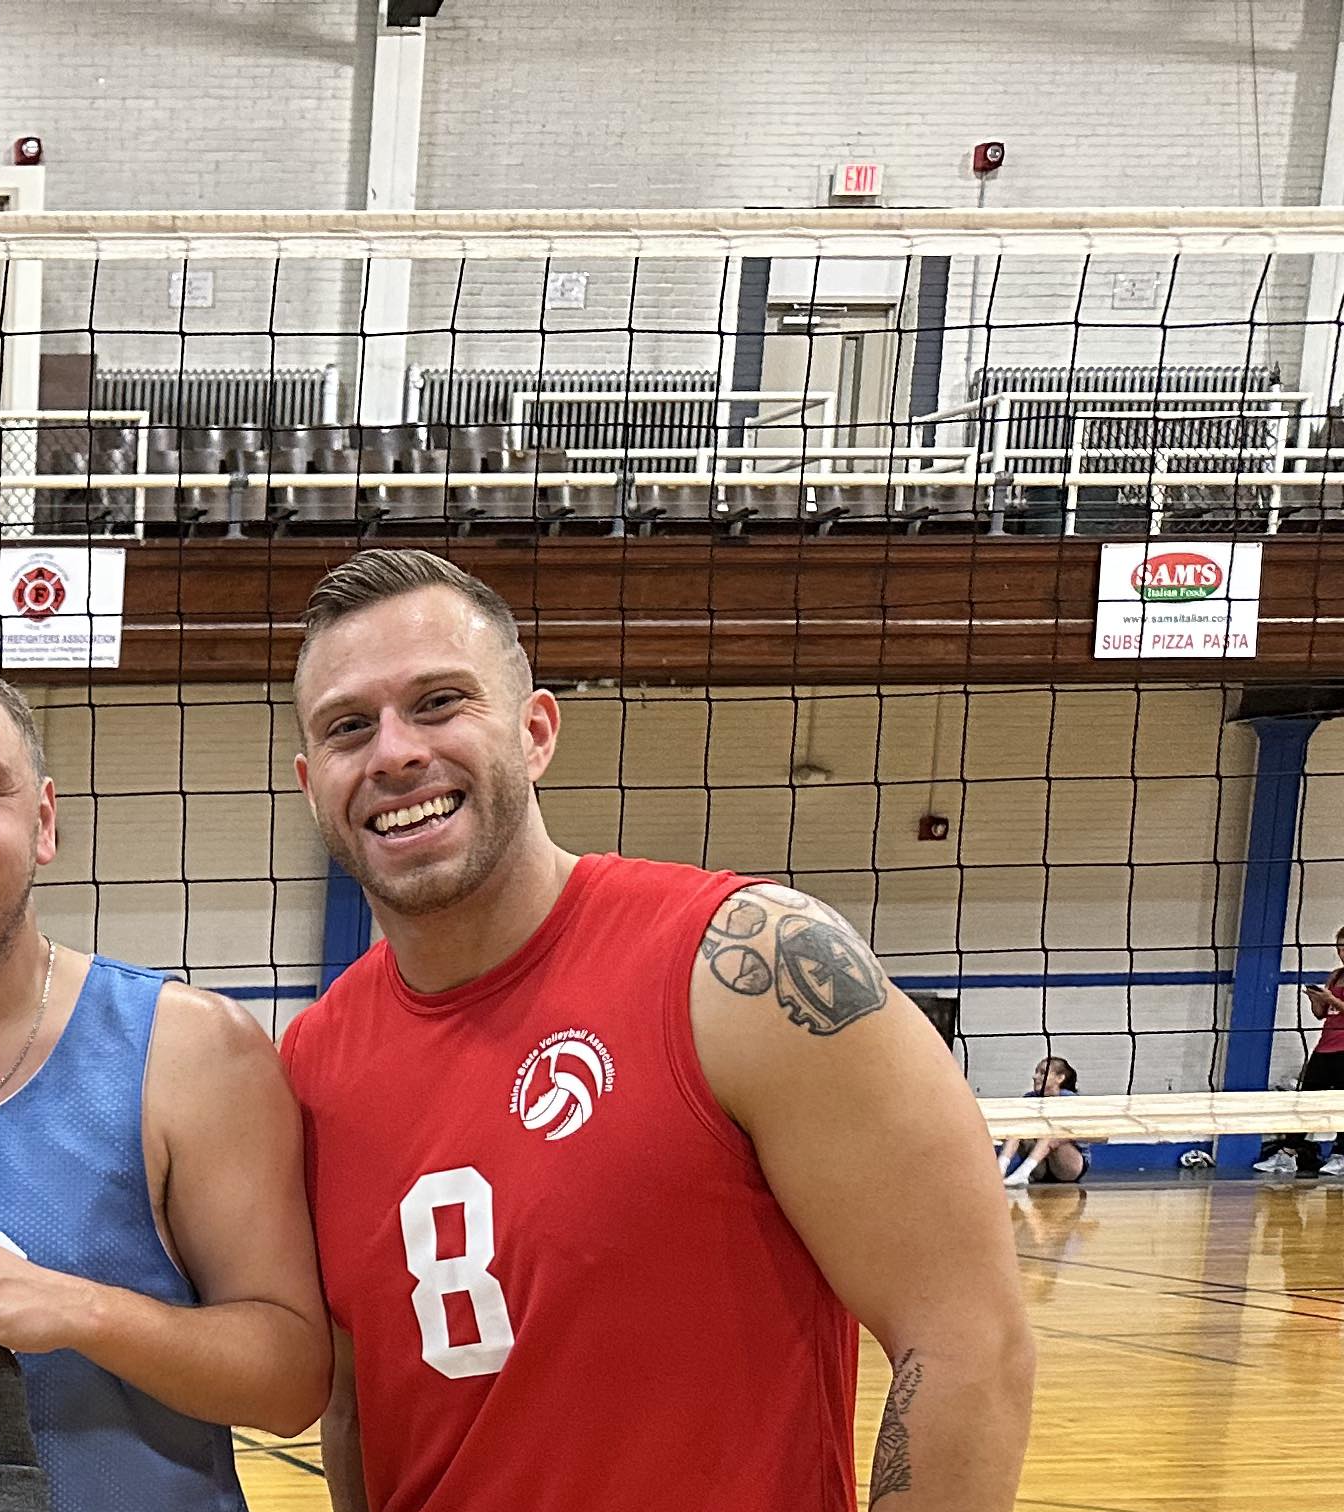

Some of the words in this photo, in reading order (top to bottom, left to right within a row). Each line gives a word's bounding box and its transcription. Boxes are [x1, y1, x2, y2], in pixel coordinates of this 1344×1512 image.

[844, 165, 878, 192] EXIT
[1135, 563, 1217, 586] SAM'S
[1147, 587, 1178, 598] Italian
[1180, 587, 1207, 598] Foods
[1102, 634, 1141, 650] SUBS
[1152, 634, 1194, 650] PIZZA
[1203, 633, 1249, 649] PASTA
[539, 1028, 588, 1048] Volleyball
[586, 1033, 616, 1093] Association
[399, 1165, 515, 1379] 8
